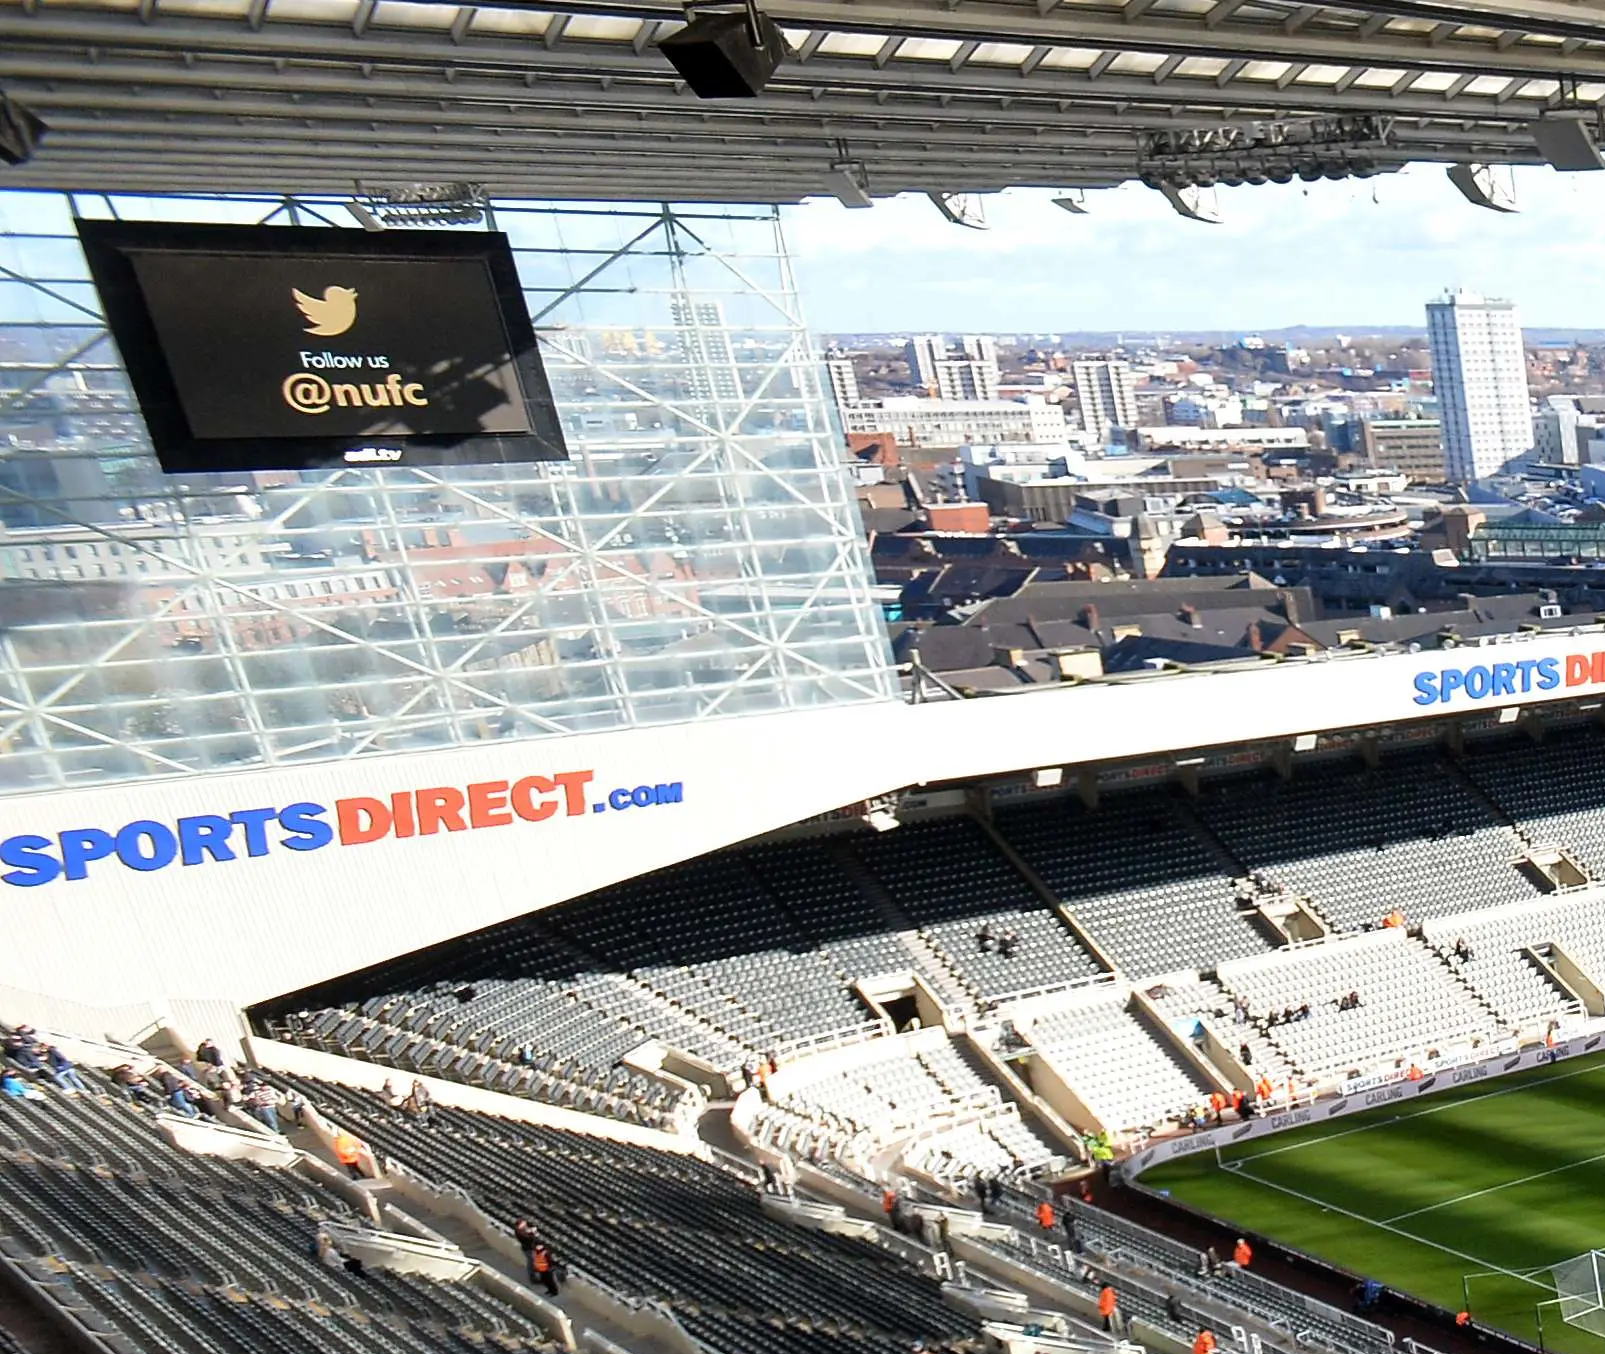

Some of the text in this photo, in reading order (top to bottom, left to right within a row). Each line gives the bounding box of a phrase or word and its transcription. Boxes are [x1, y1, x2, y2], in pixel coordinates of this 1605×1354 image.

[299, 351, 390, 369] Follow us
[282, 372, 429, 414] @nufc
[1452, 1065, 1488, 1085] CARLING
[1365, 1086, 1404, 1106] CARLING
